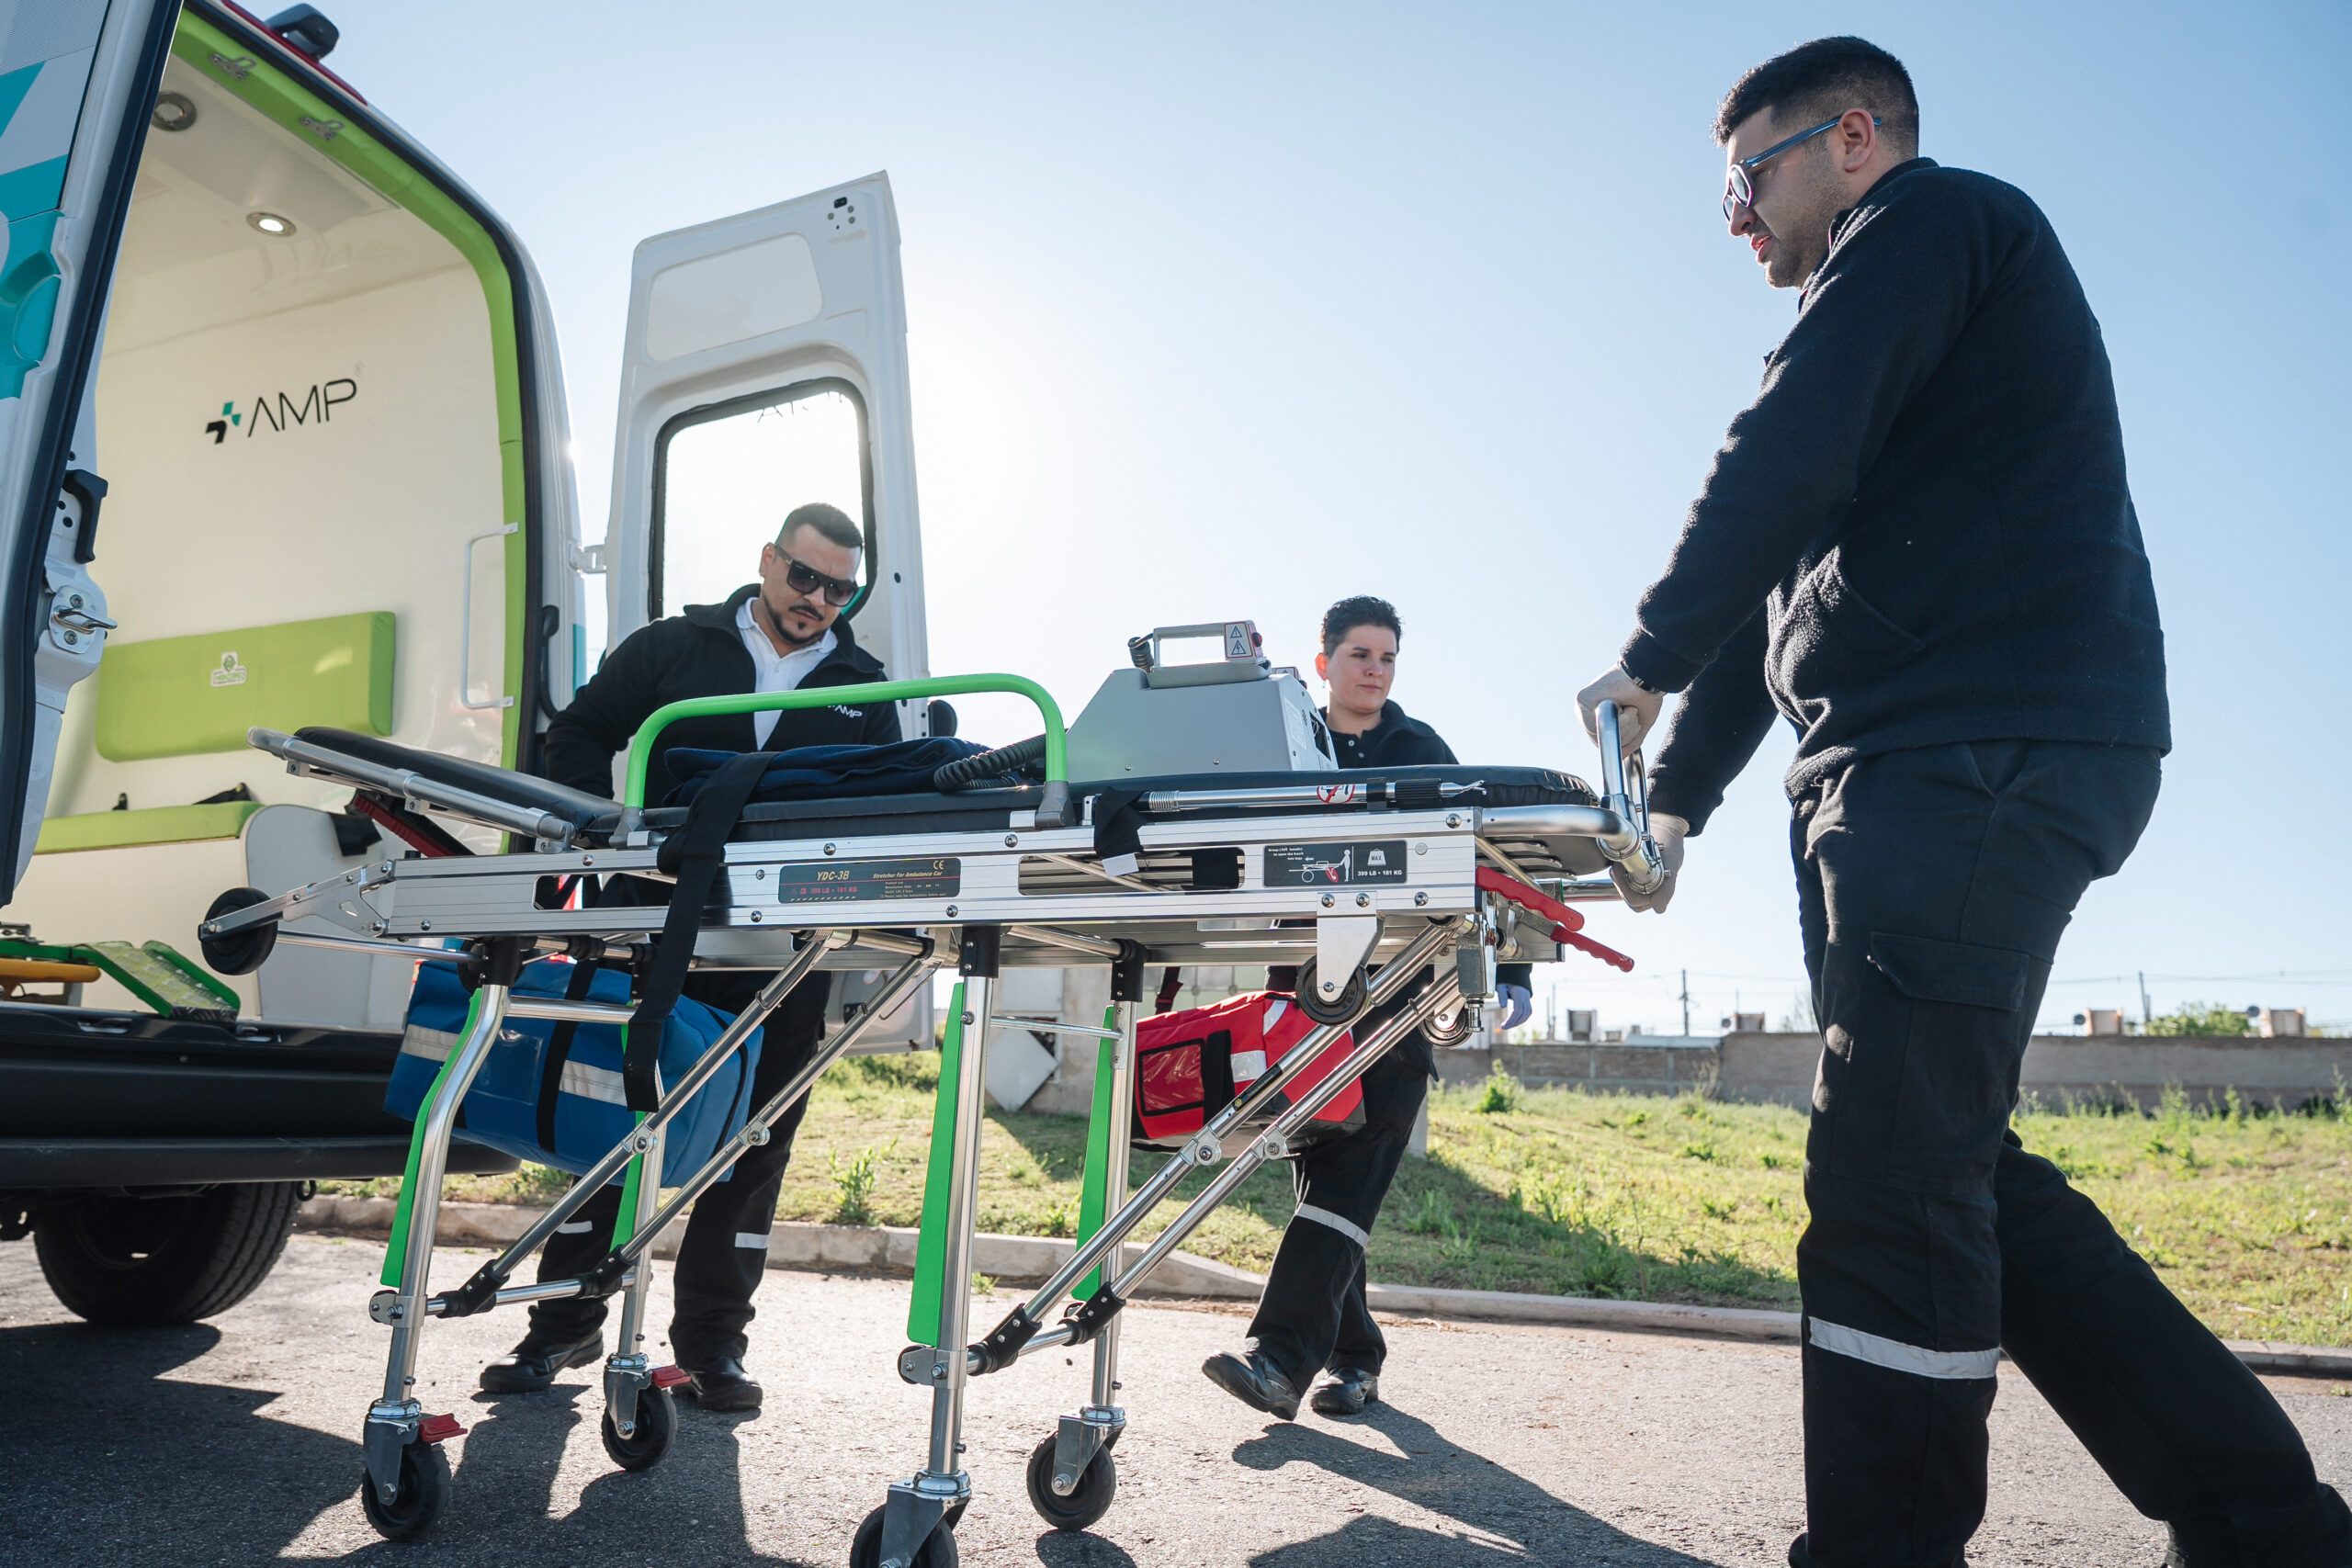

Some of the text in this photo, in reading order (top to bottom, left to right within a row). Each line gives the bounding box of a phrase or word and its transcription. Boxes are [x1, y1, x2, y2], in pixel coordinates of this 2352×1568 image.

[247, 378, 357, 437] AMP
[834, 705, 863, 718] AMP
[817, 870, 850, 881] YDC-3B
